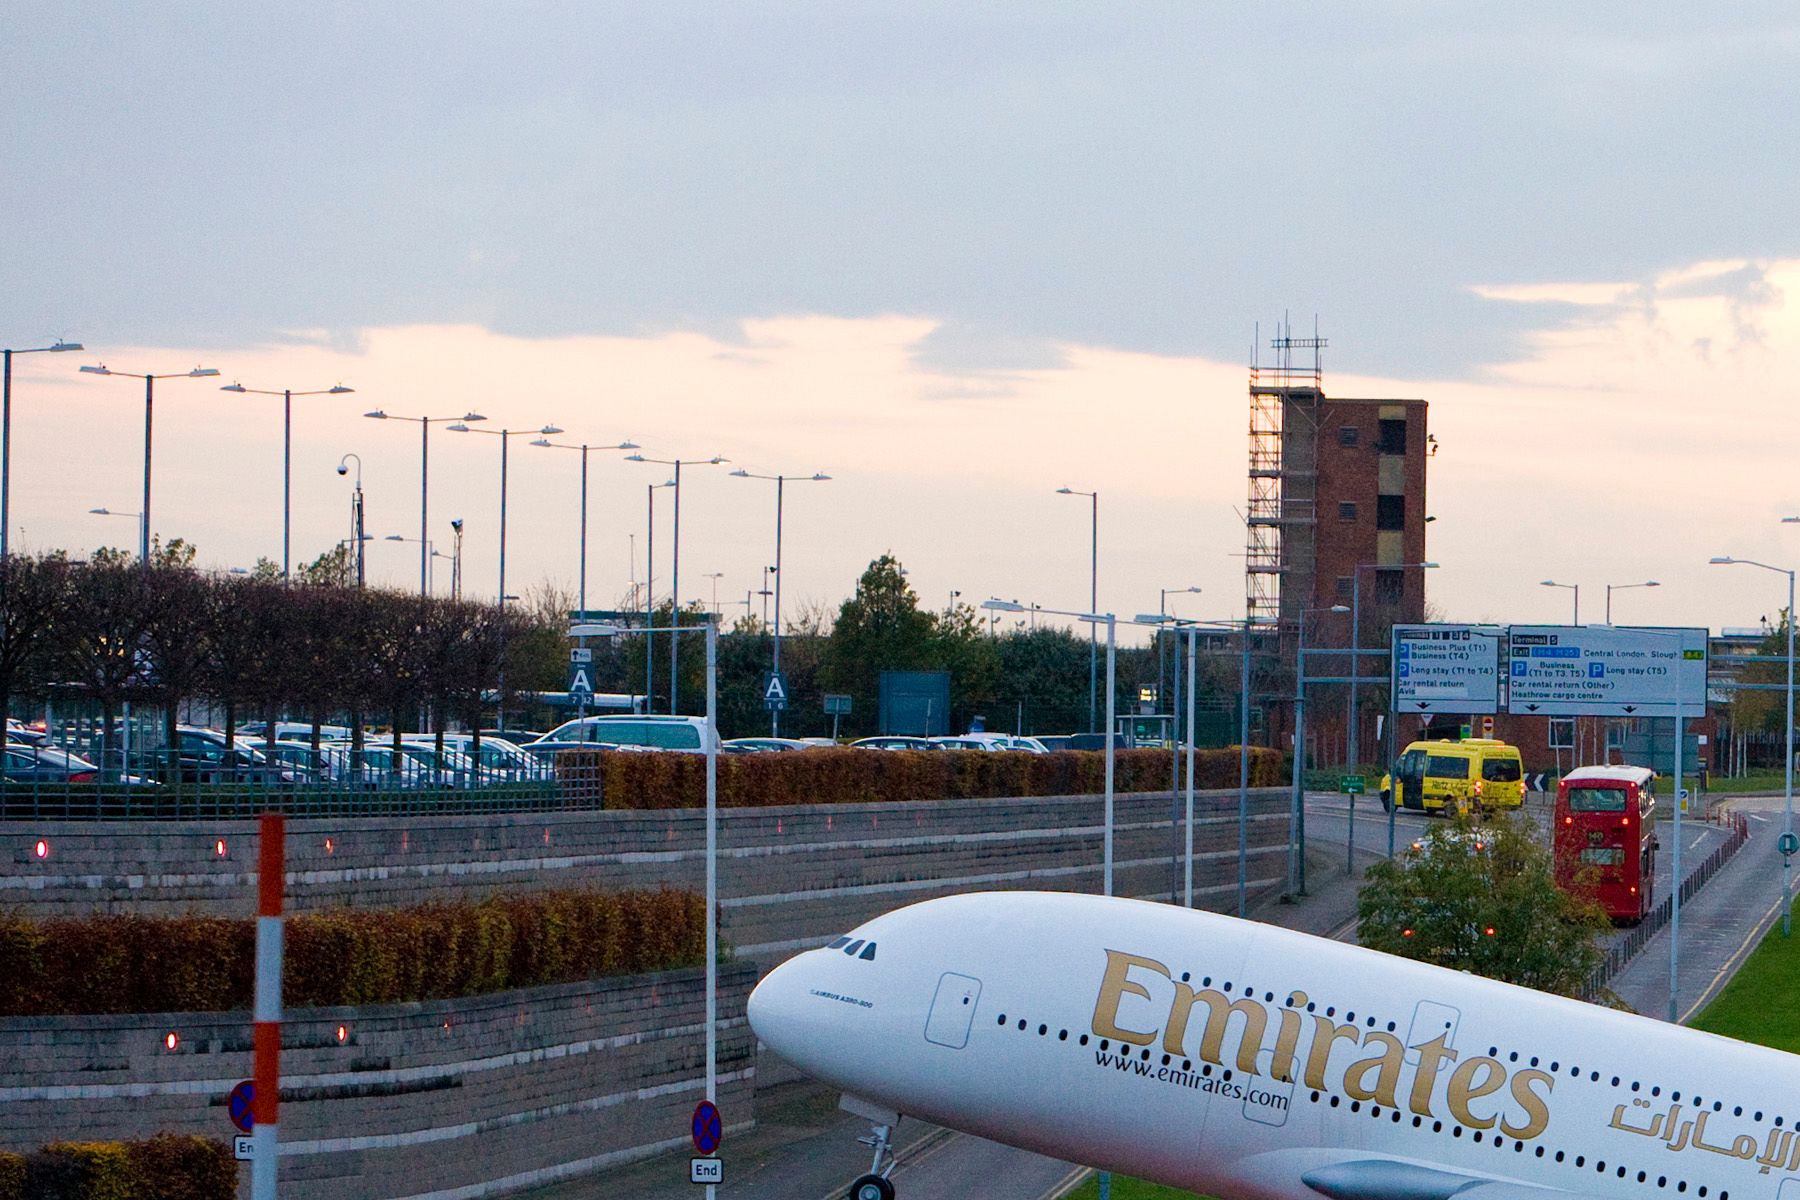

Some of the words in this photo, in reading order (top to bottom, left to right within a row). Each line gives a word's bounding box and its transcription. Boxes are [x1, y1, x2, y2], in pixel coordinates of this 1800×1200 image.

[1513, 636, 1547, 645] Terminal
[1411, 643, 1446, 651] Business
[1469, 643, 1486, 652] (T1)
[1449, 652, 1469, 660] (T4)
[1540, 661, 1575, 669] Business
[1432, 667, 1449, 675] stay
[1606, 667, 1625, 675] Long
[1628, 667, 1645, 675] stay
[570, 670, 591, 692] A
[1512, 680, 1526, 688] Car
[1528, 680, 1552, 688] rental
[1582, 681, 1615, 689] (Other)
[765, 677, 785, 698] A
[1552, 692, 1575, 700] cargo
[1577, 691, 1603, 699] centre
[1090, 948, 1555, 1140] Emirates
[1095, 1050, 1288, 1111] www.emirates.com
[239, 1142, 254, 1153] En
[696, 1164, 718, 1176] End
